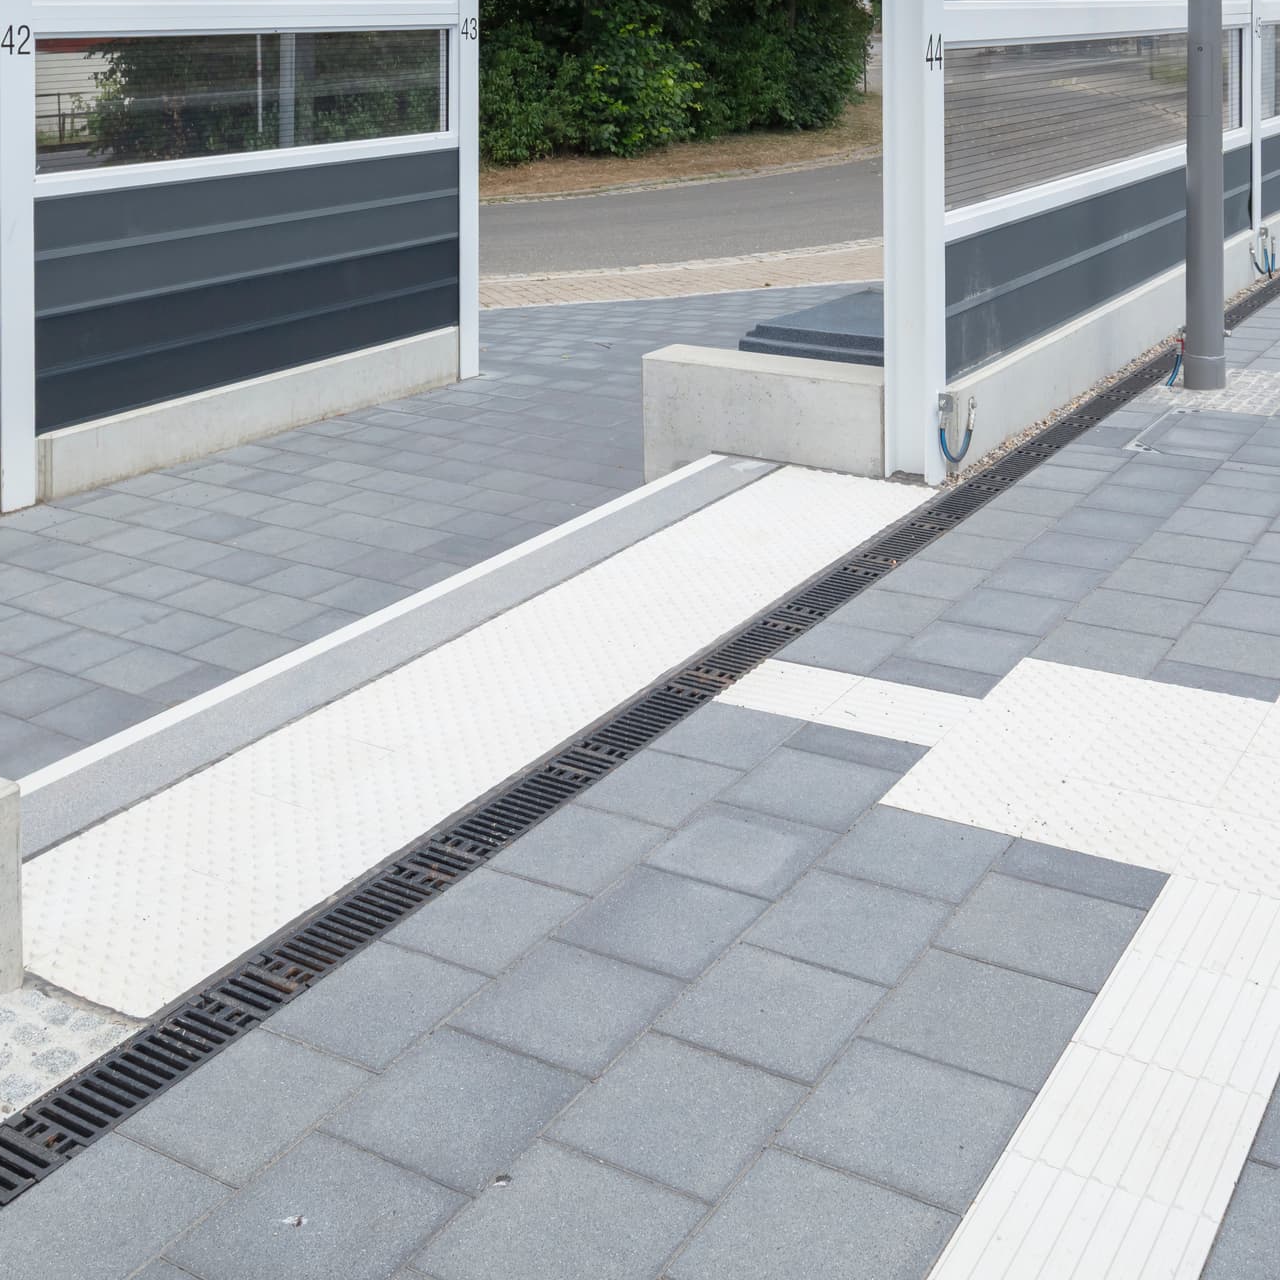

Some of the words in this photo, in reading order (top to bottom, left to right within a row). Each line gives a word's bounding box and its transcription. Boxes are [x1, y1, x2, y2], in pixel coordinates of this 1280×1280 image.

[0, 24, 32, 56] 42
[461, 17, 477, 40] 43
[925, 32, 943, 71] 44
